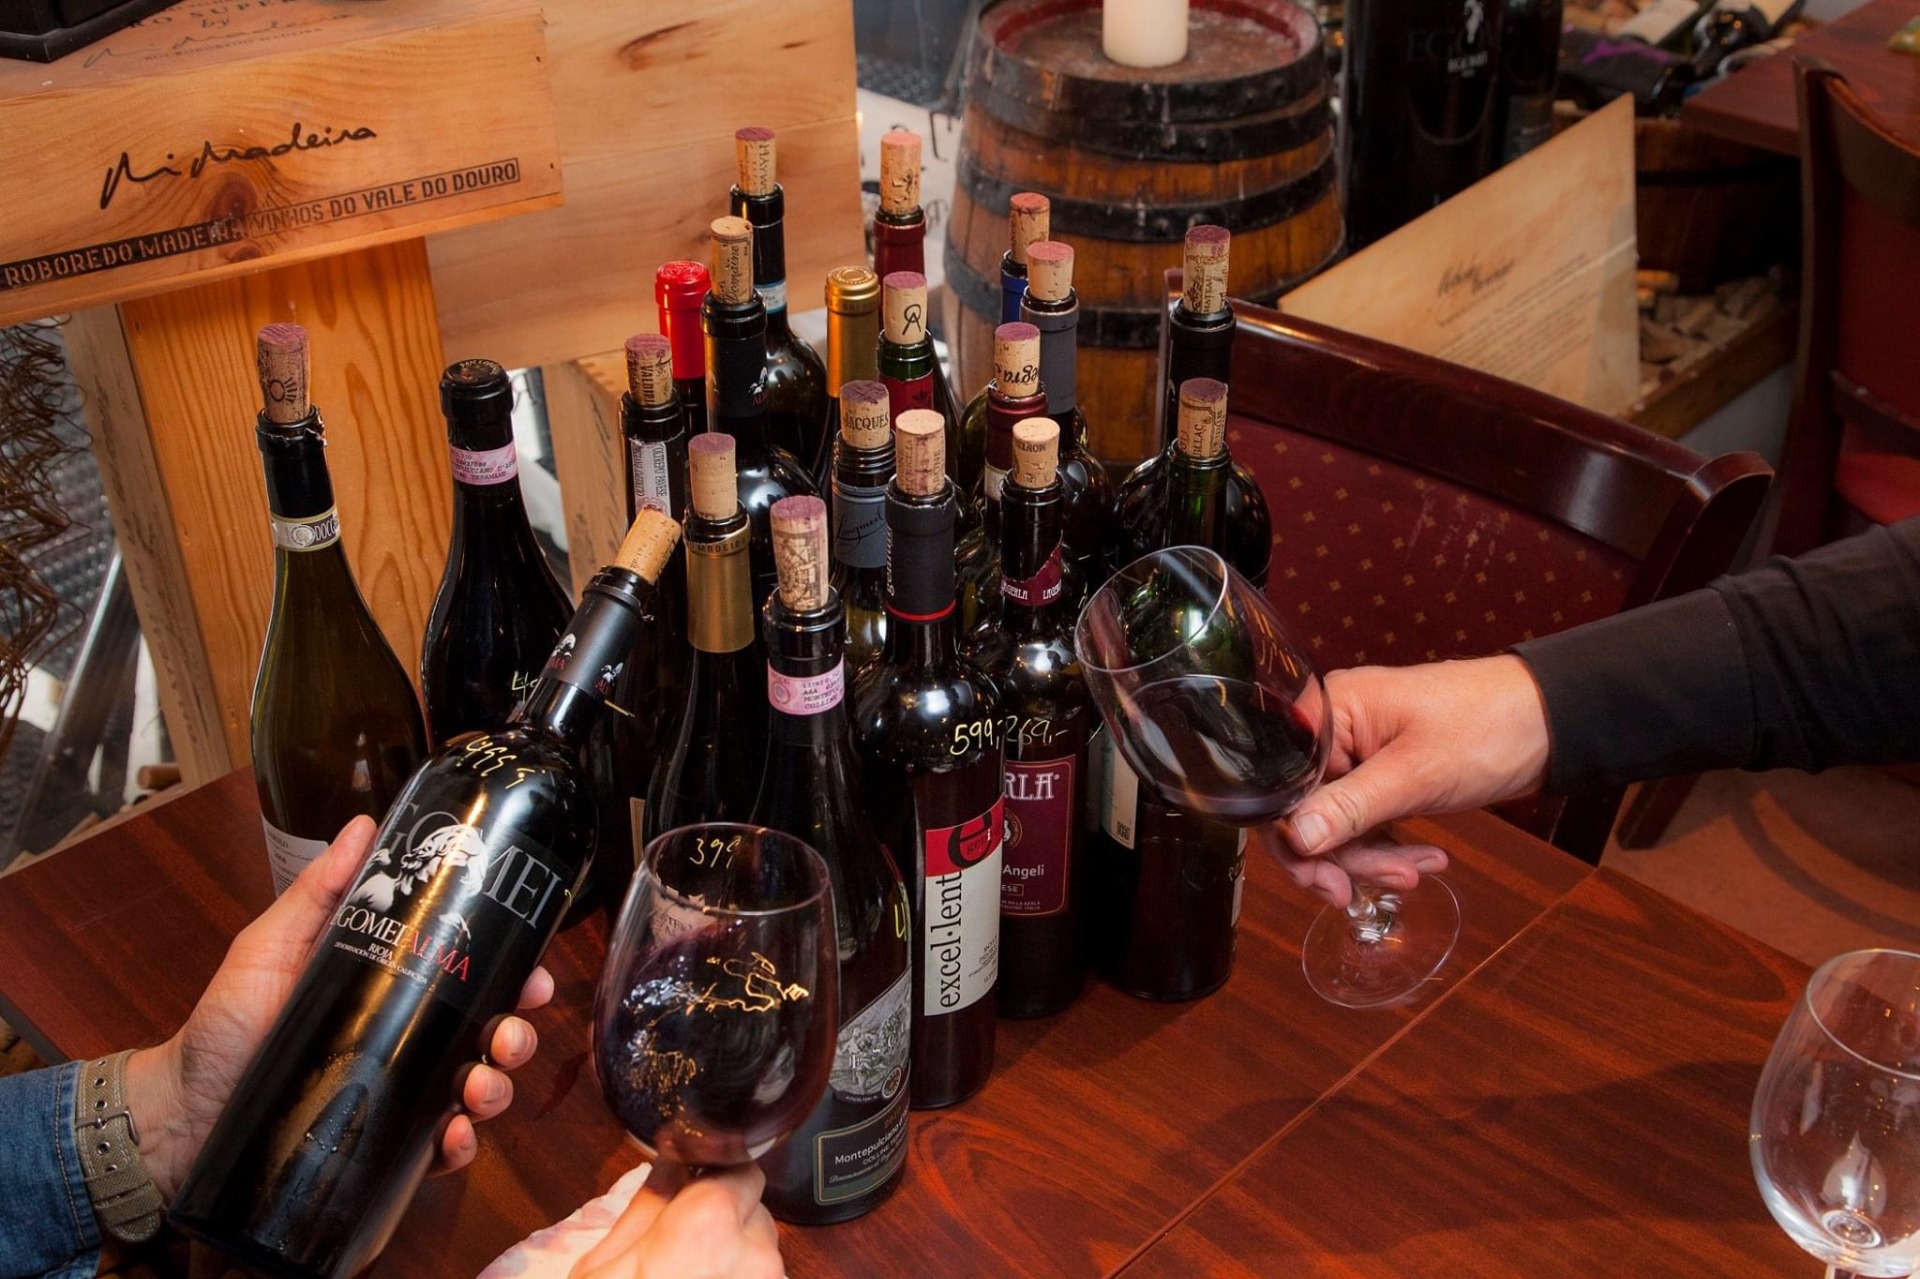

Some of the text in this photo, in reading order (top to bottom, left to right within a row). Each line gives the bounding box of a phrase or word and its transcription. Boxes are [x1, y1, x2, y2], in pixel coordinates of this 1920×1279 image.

[4, 162, 518, 287] ROBOREDO MADEIRA VINHOS DO VALE DO DOURO
[1002, 864, 1045, 886] Angeli
[1002, 884, 1019, 893] ESE
[368, 942, 394, 960] RIOJA
[410, 930, 471, 982] ALMA
[834, 1122, 899, 1166] Montepulciano
